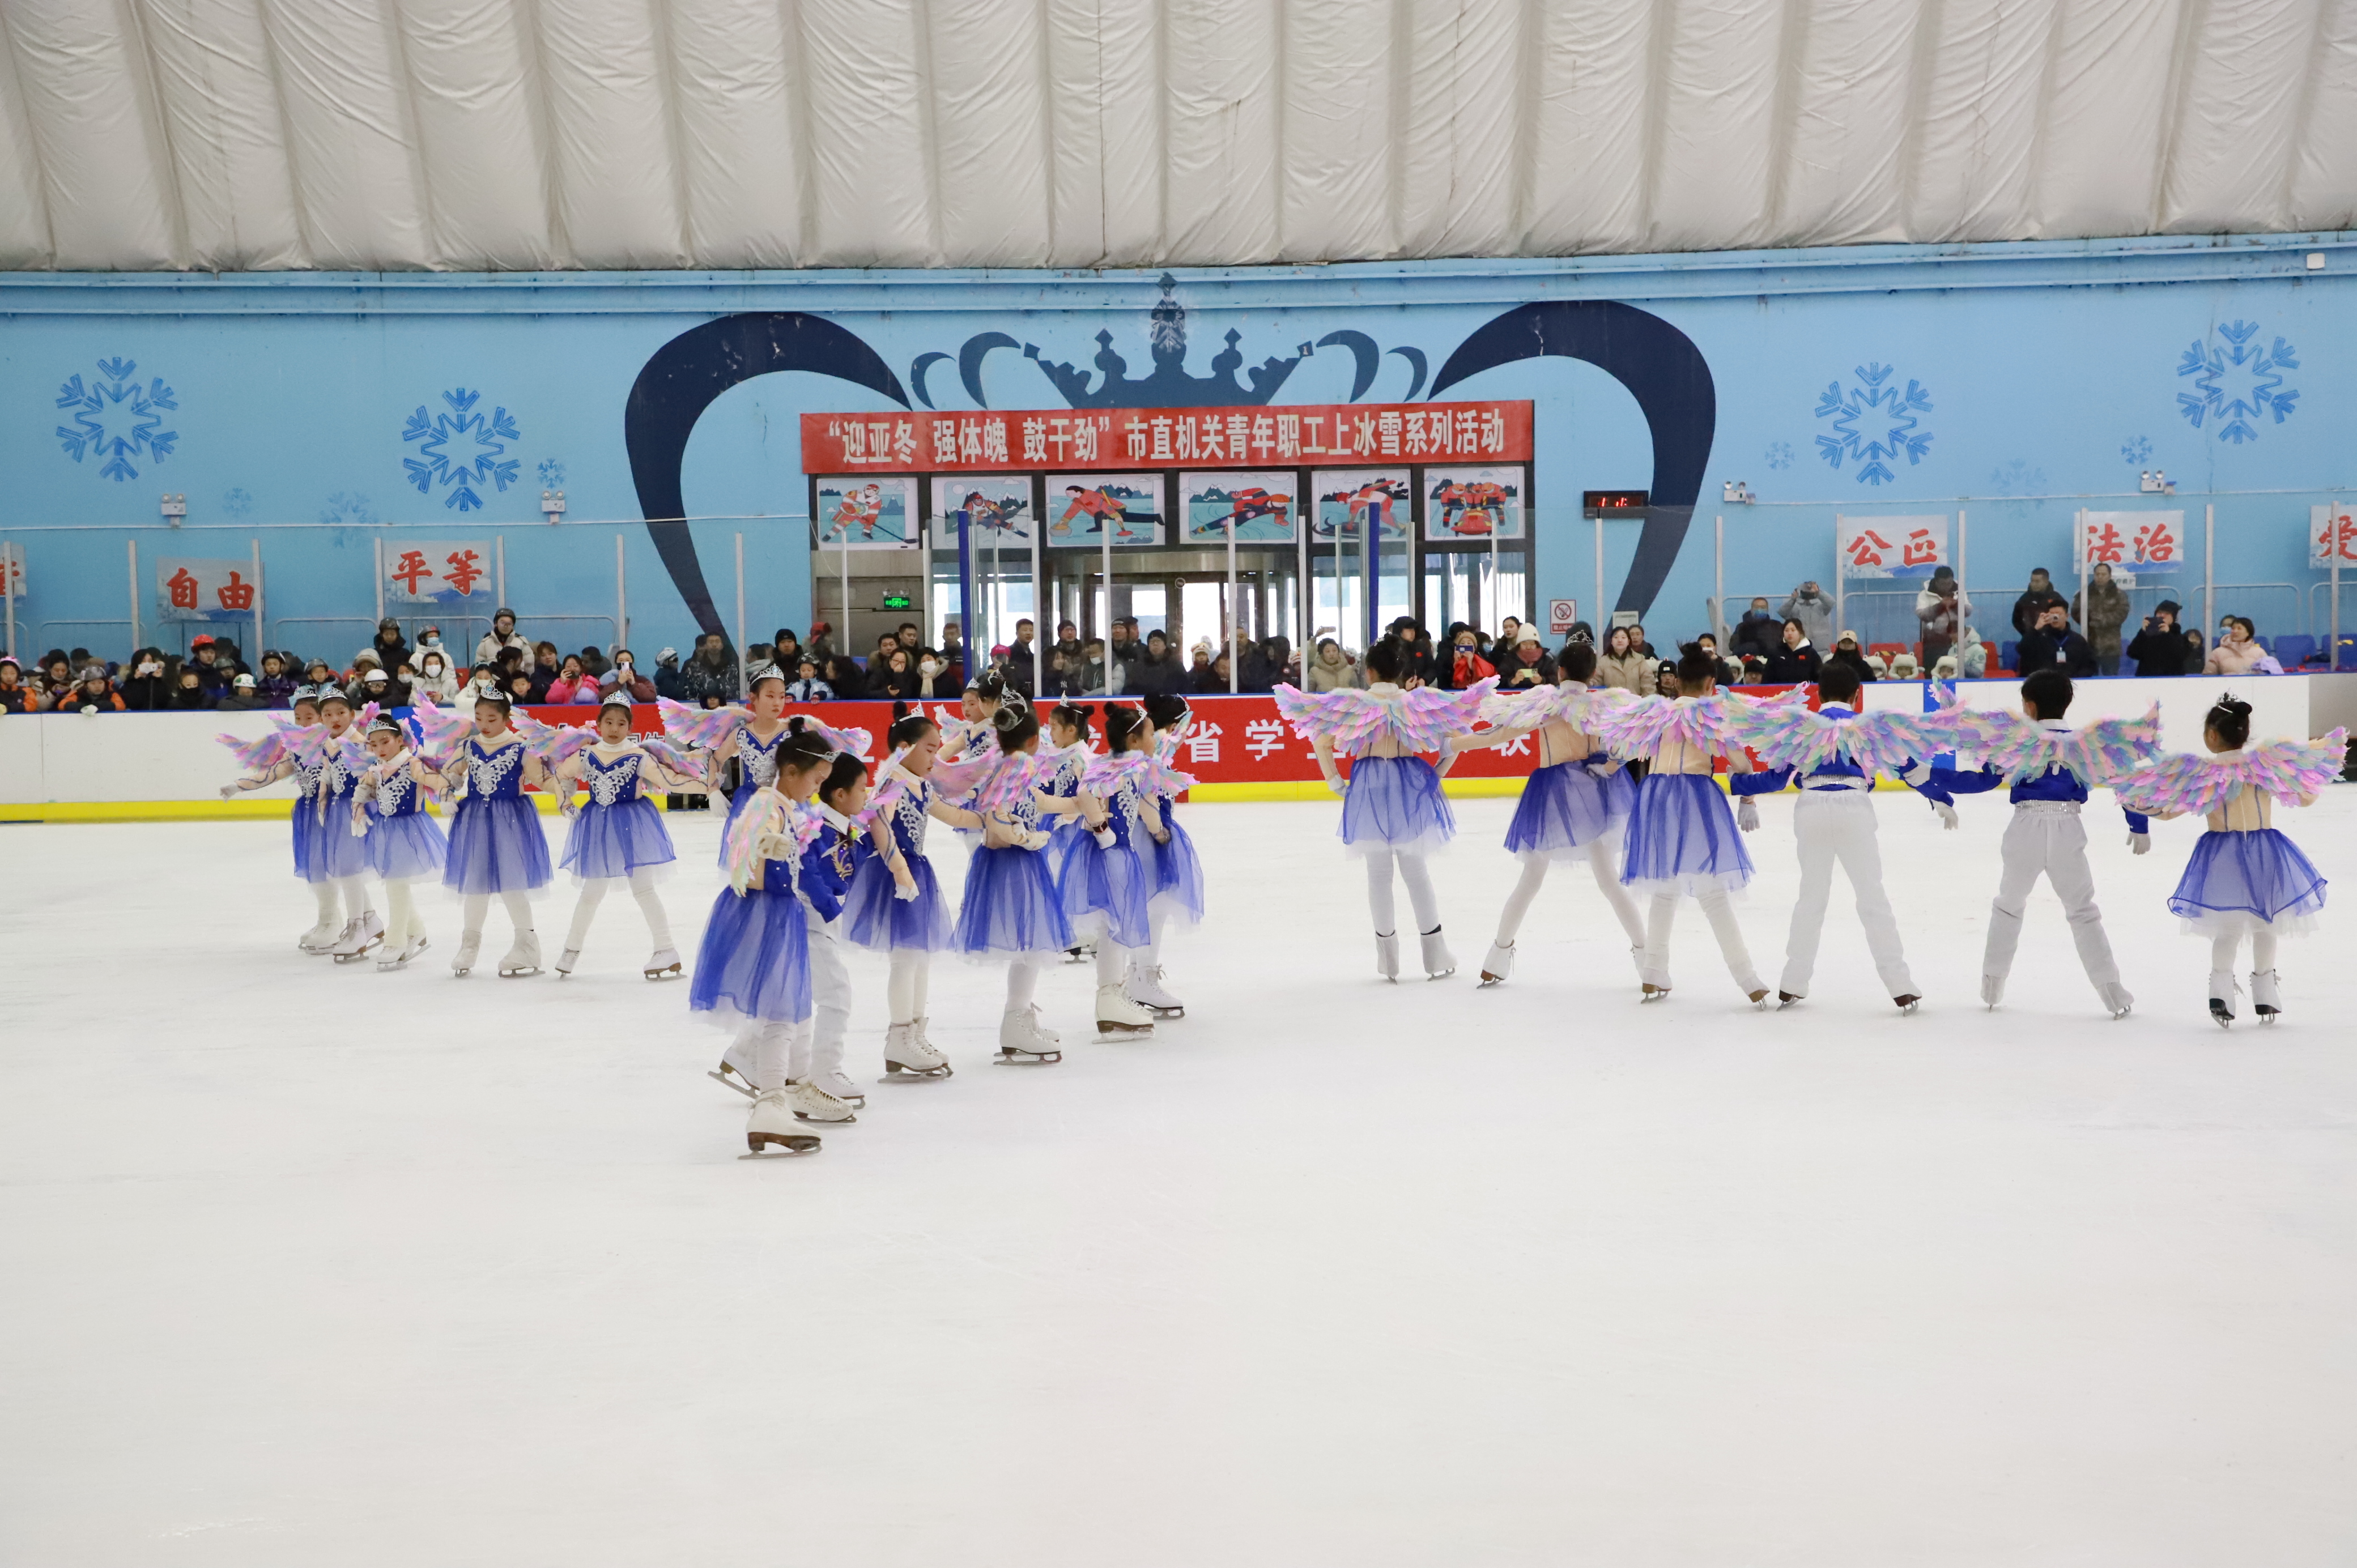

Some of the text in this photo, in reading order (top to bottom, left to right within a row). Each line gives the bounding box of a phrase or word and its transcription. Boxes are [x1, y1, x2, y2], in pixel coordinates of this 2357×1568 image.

[828, 408, 1504, 465] “迎亚冬 强体魄 鼓干劲” 市直机关青年职工上冰雪系列活动
[1846, 528, 1938, 566] 公正
[2087, 523, 2175, 563] 法治
[166, 567, 254, 610] 自由
[391, 549, 483, 595] 平等
